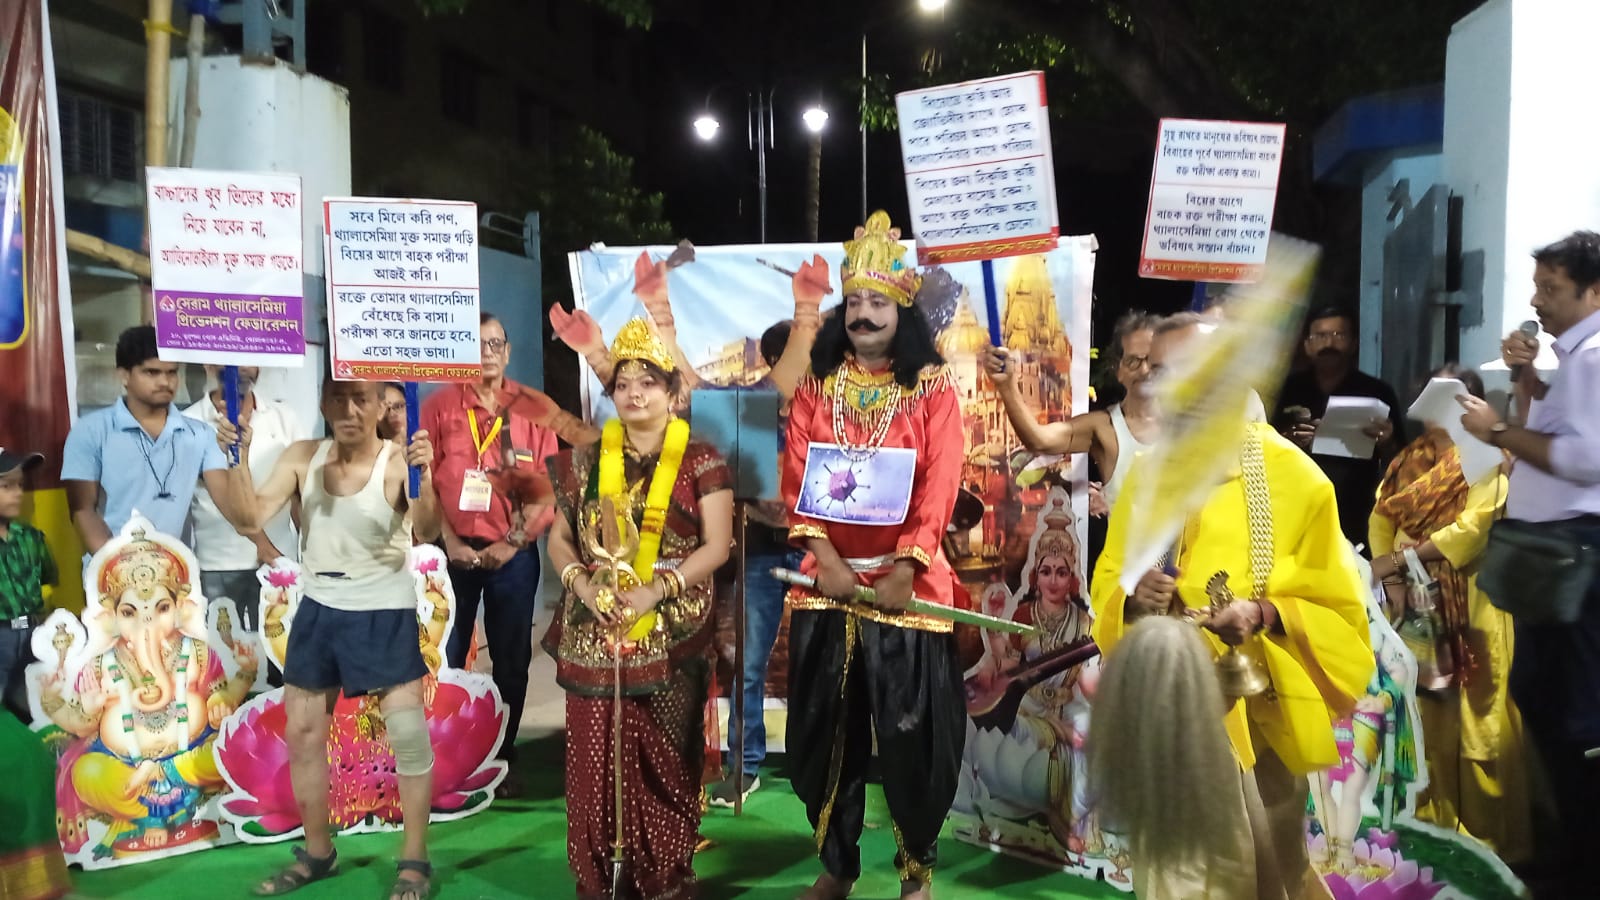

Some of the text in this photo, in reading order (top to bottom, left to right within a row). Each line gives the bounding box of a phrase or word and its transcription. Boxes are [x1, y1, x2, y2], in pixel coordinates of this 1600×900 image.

[205, 187, 221, 211] খুব
[228, 184, 264, 208] ভিড়ের
[271, 191, 296, 209] মধ্যে
[1186, 192, 1243, 207] বিয়ের আগে
[349, 208, 458, 226] সবে মিলে করি পণ,
[1157, 210, 1182, 221] বাহক
[1186, 211, 1202, 222] রক্ত
[1207, 209, 1238, 222] পরীক্ষা
[184, 212, 266, 238] নিয়ে যাবেন না,
[1154, 224, 1266, 240] থ্যালাসেমিয়া রোগ থেকে
[334, 227, 474, 246] থ্যালাসেমিয়া মুক্ত সমাজ গড়ি
[341, 245, 468, 264] বিয়ের আগে বাহক পরীক্ষা
[374, 266, 407, 282] আজই
[176, 296, 287, 316] সেরাম থ্যালাসেমিয়া
[338, 290, 474, 306] রক্তে তোমার থ্যালাসেমিয়া
[362, 306, 404, 323] বেঁধেছে
[406, 308, 420, 323] কি
[340, 324, 476, 343] পরীক্ষা করে জানতে হবে,
[362, 346, 392, 358] এতো
[394, 346, 421, 359] সহজ
